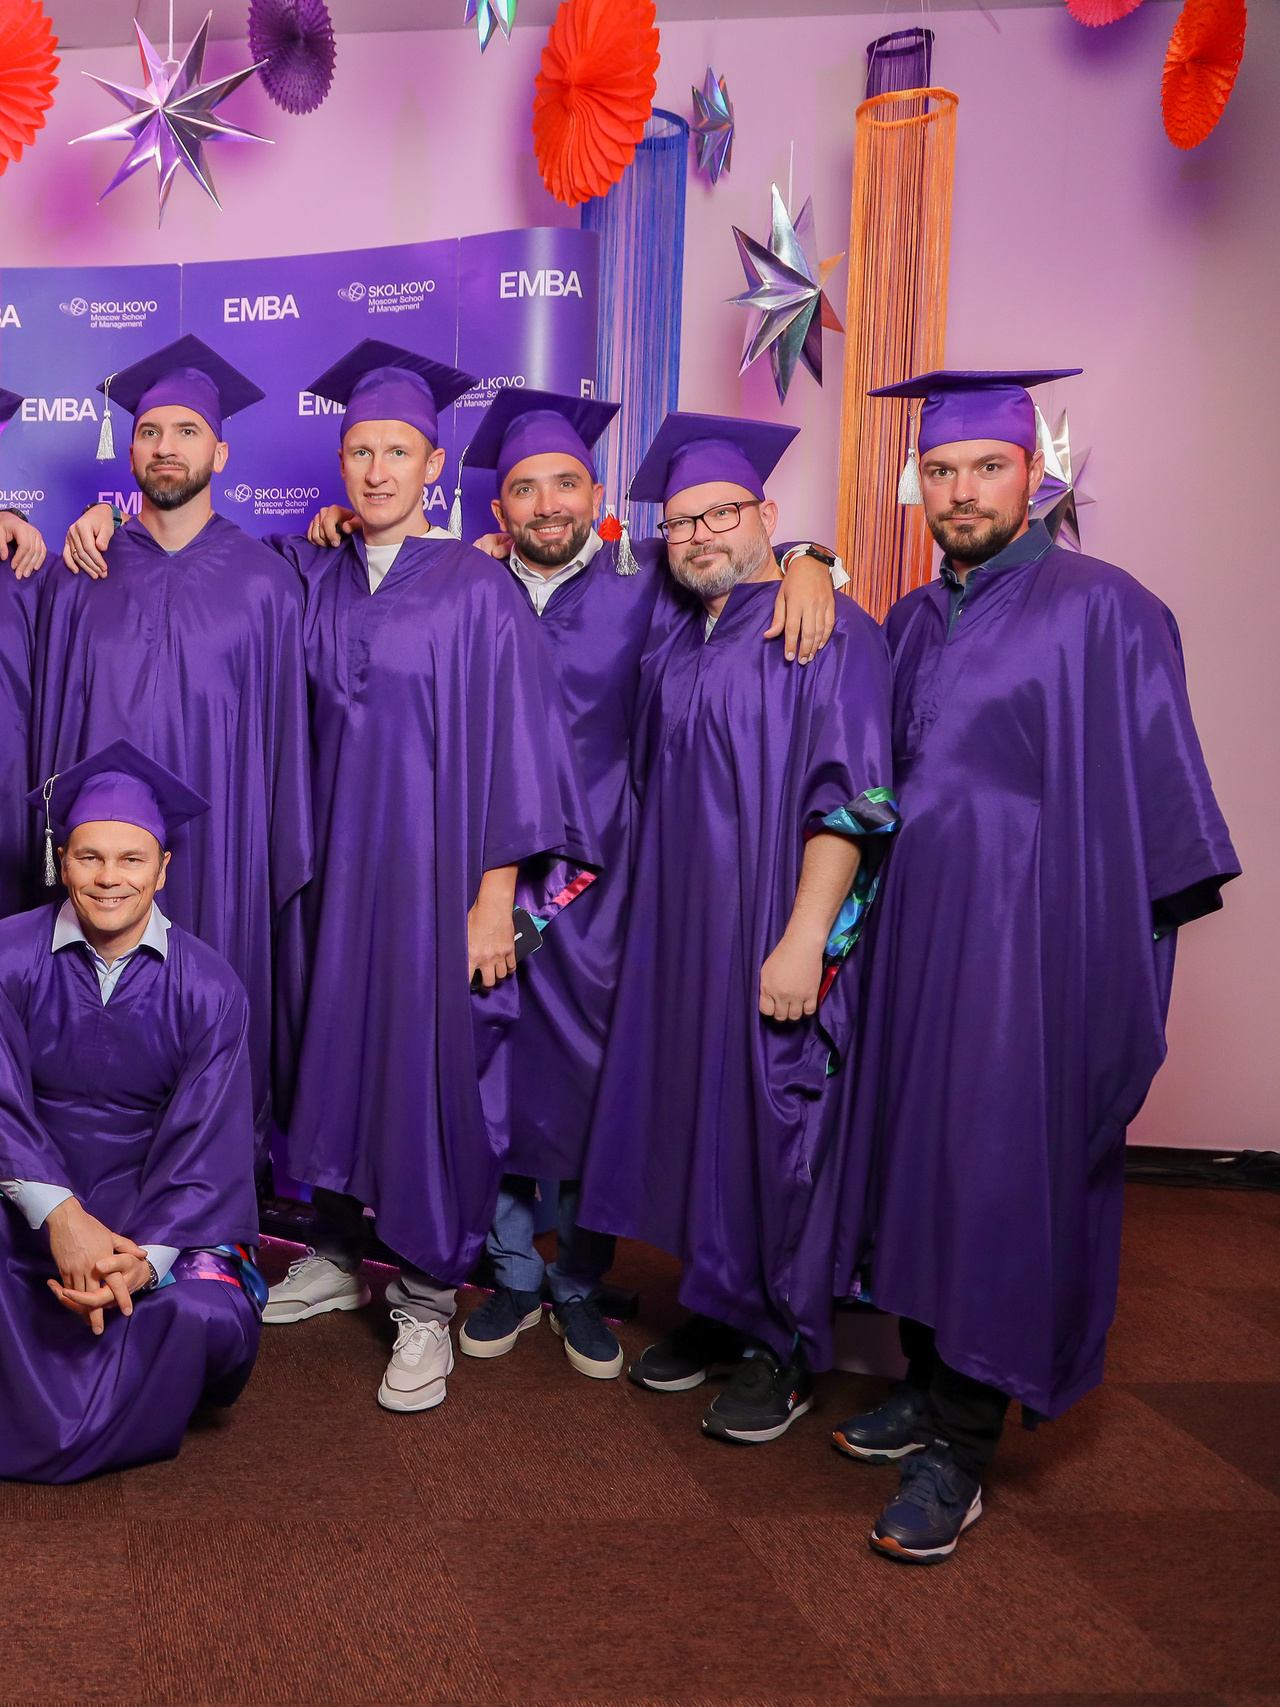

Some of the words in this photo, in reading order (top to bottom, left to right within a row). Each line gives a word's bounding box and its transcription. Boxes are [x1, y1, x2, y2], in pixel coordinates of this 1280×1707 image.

[368, 279, 435, 298] SKOLKOVO
[500, 269, 583, 299] EMBA
[368, 297, 398, 306] Moscow
[399, 294, 424, 303] School
[90, 300, 158, 314] SKOLKOVO
[223, 294, 300, 323] EMBA
[368, 306, 376, 314] of
[376, 302, 420, 313] Management
[90, 314, 120, 322] Moscow
[122, 313, 147, 321] School
[98, 320, 143, 329] Management
[21, 397, 99, 422] EMBA
[455, 400, 463, 408] of
[254, 487, 320, 500] SKOLKOVO
[254, 500, 283, 508] Moscow
[284, 499, 308, 508] School
[254, 507, 262, 515] of
[262, 507, 305, 516] Management
